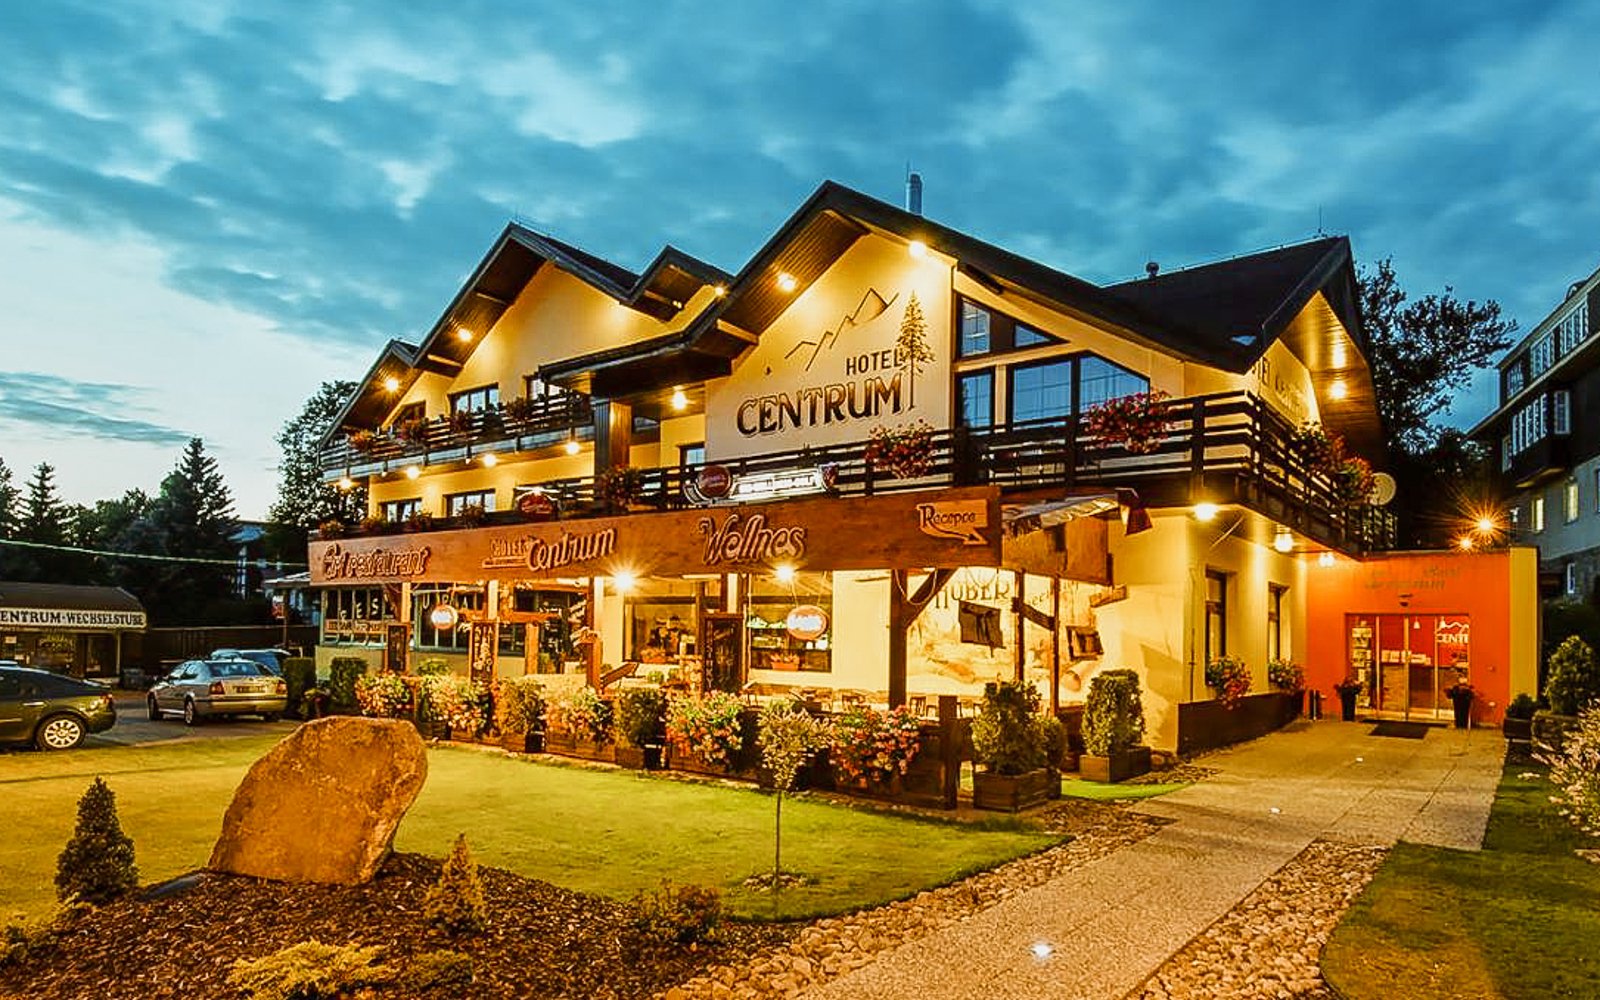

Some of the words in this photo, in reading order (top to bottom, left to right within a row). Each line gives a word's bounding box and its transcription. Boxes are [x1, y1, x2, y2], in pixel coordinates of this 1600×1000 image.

[846, 348, 903, 376] HOTEL
[736, 373, 904, 437] CENTRUM
[526, 528, 617, 572] Centrum
[698, 514, 806, 565] Wellnes
[0, 610, 61, 623] ENTRUM
